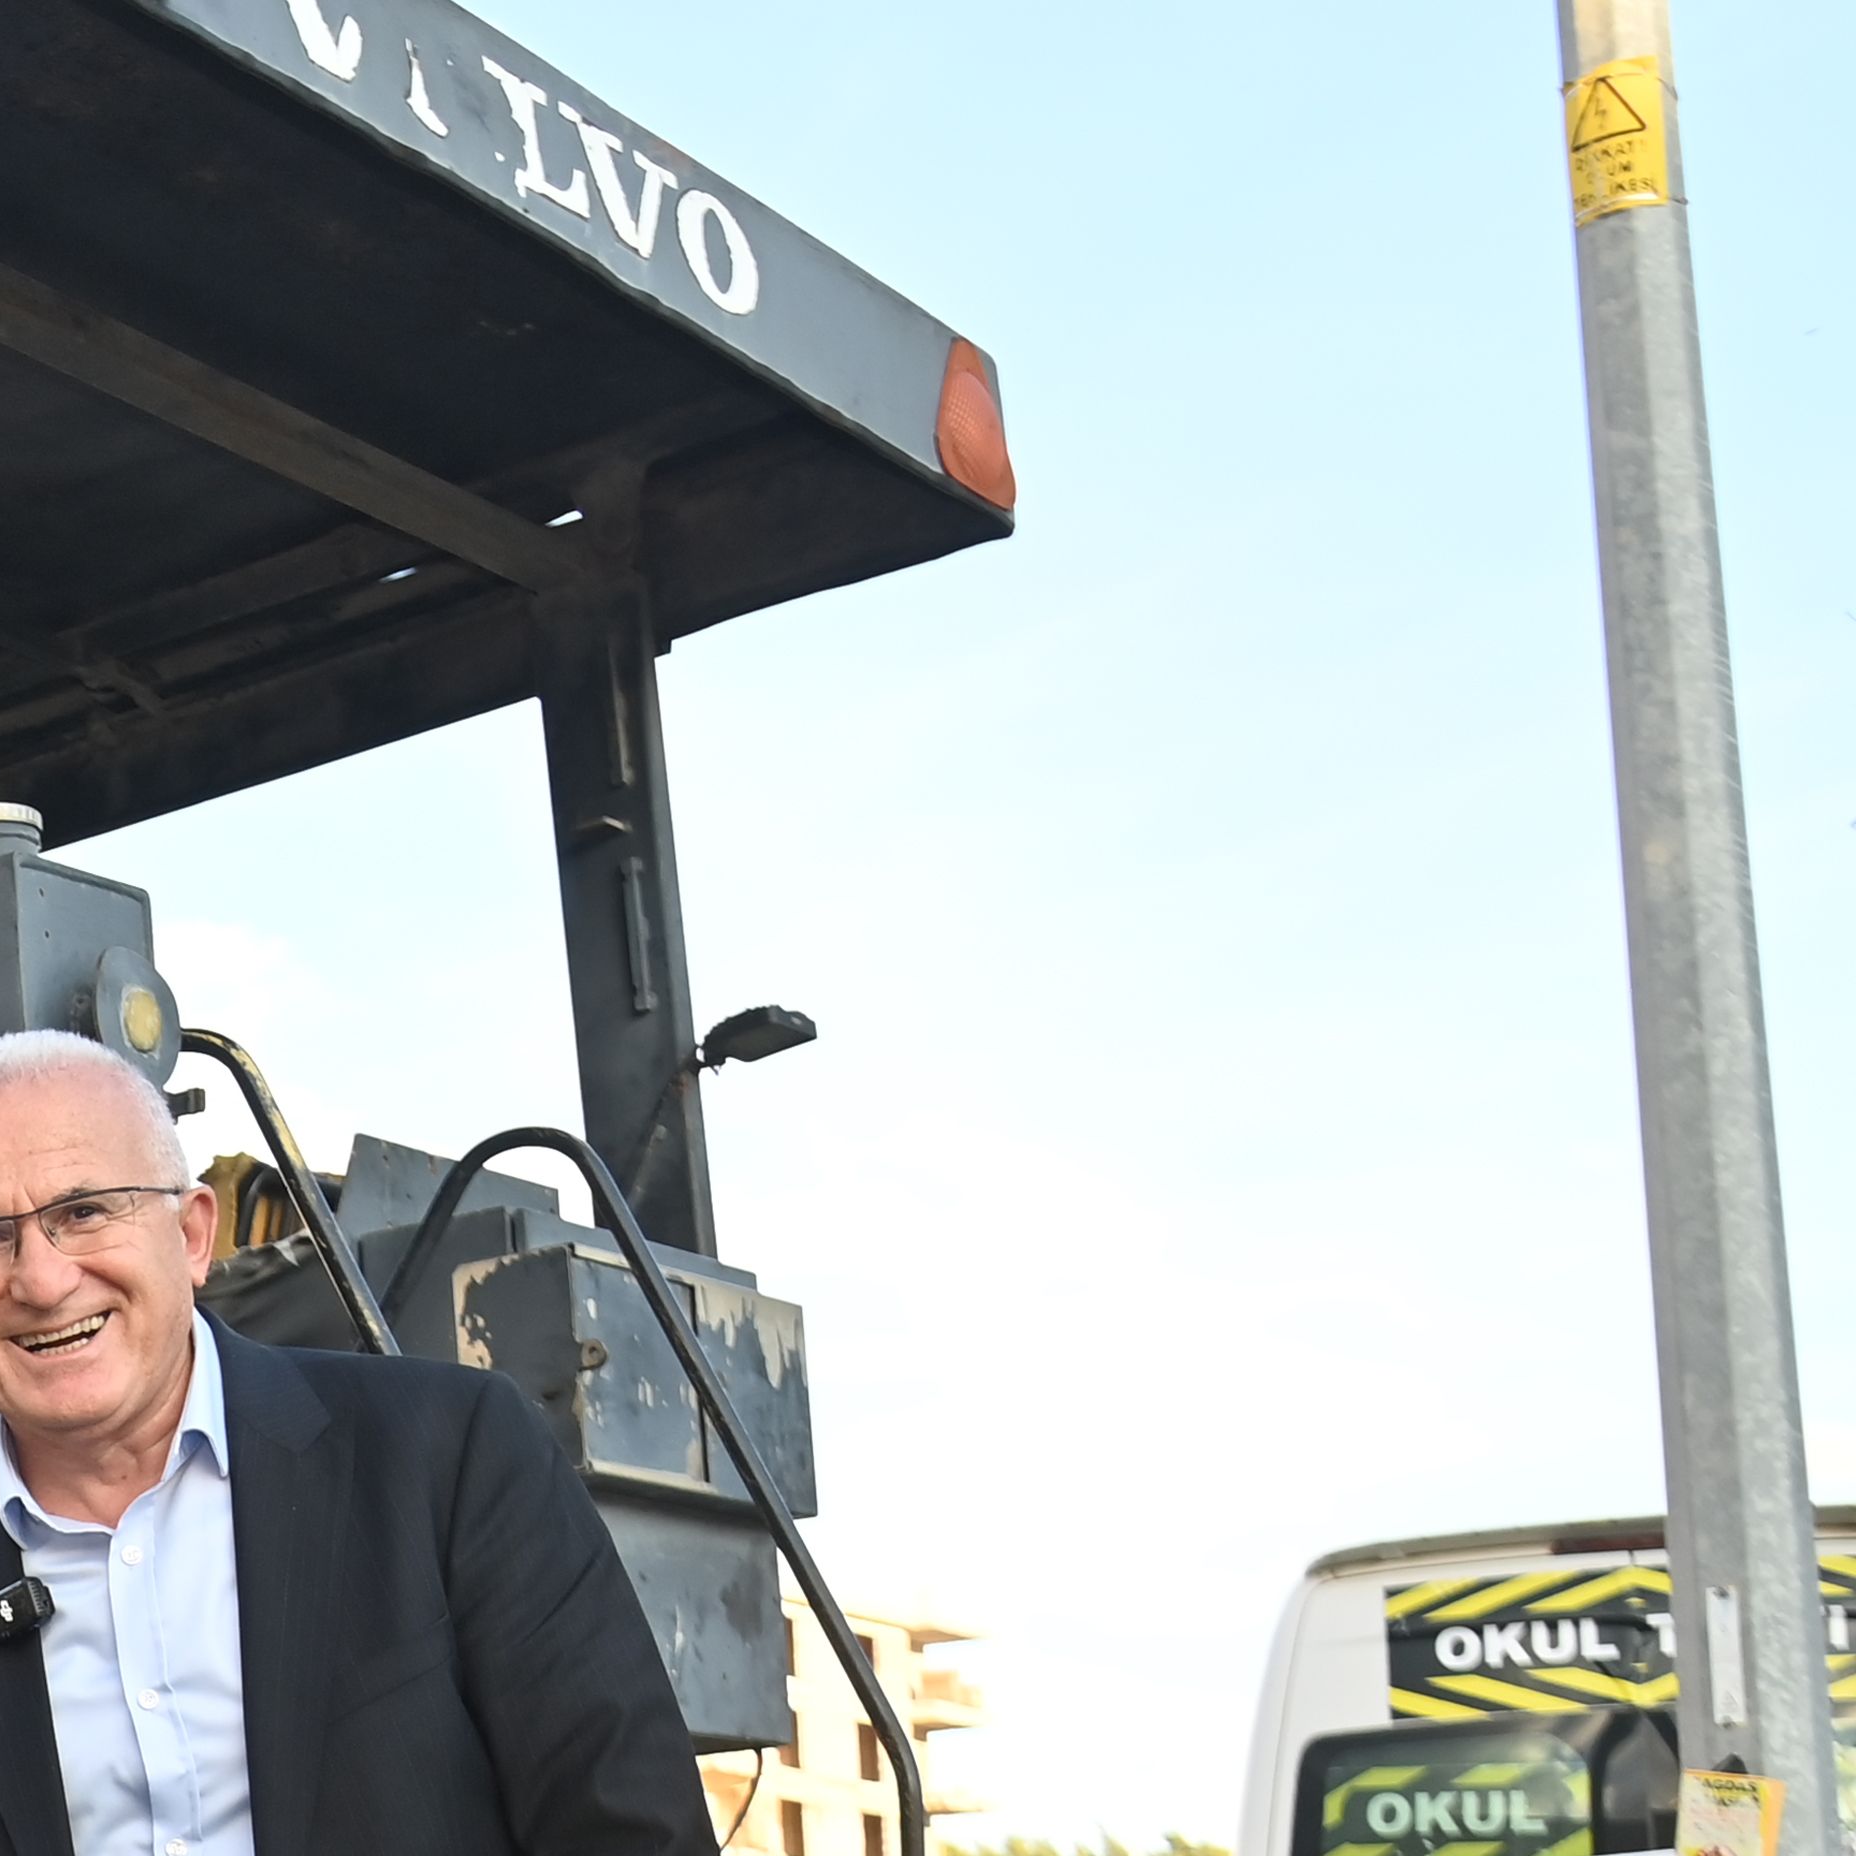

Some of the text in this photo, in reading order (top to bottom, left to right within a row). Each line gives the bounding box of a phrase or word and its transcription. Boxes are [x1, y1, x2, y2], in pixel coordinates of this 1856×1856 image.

[287, 0, 760, 316] VLVO
[1434, 1616, 1621, 1672] OKUL
[1366, 1789, 1549, 1838] OKUL
